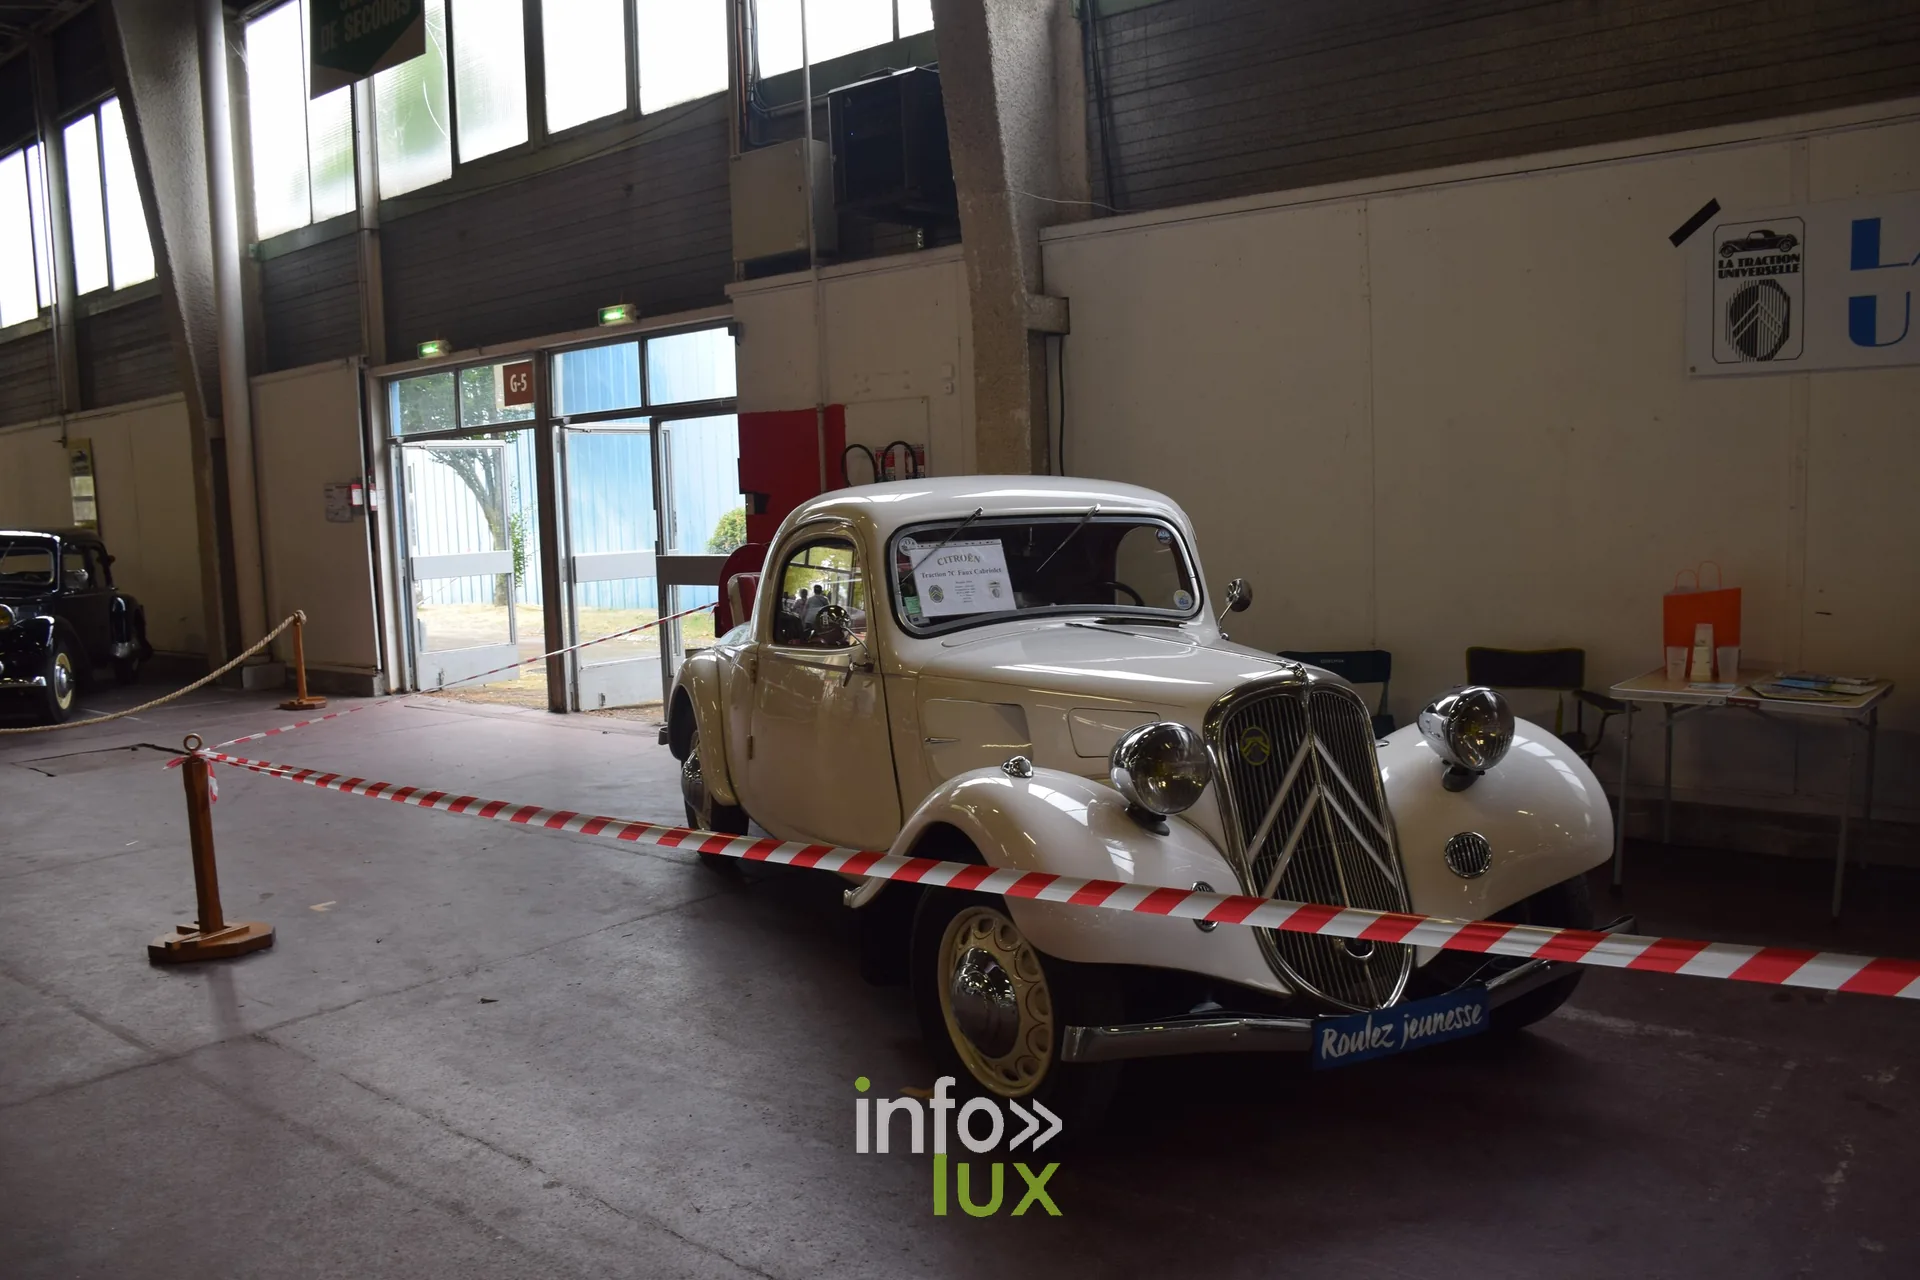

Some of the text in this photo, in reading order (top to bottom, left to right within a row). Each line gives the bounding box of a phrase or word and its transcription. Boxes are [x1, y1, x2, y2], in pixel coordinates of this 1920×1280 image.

[320, 20, 338, 54] DE
[1718, 253, 1801, 270] LA TRACTION
[1718, 263, 1801, 279] UNIVERSELLE
[510, 372, 527, 392] G-5
[1321, 1003, 1482, 1060] Roulez jeunesse
